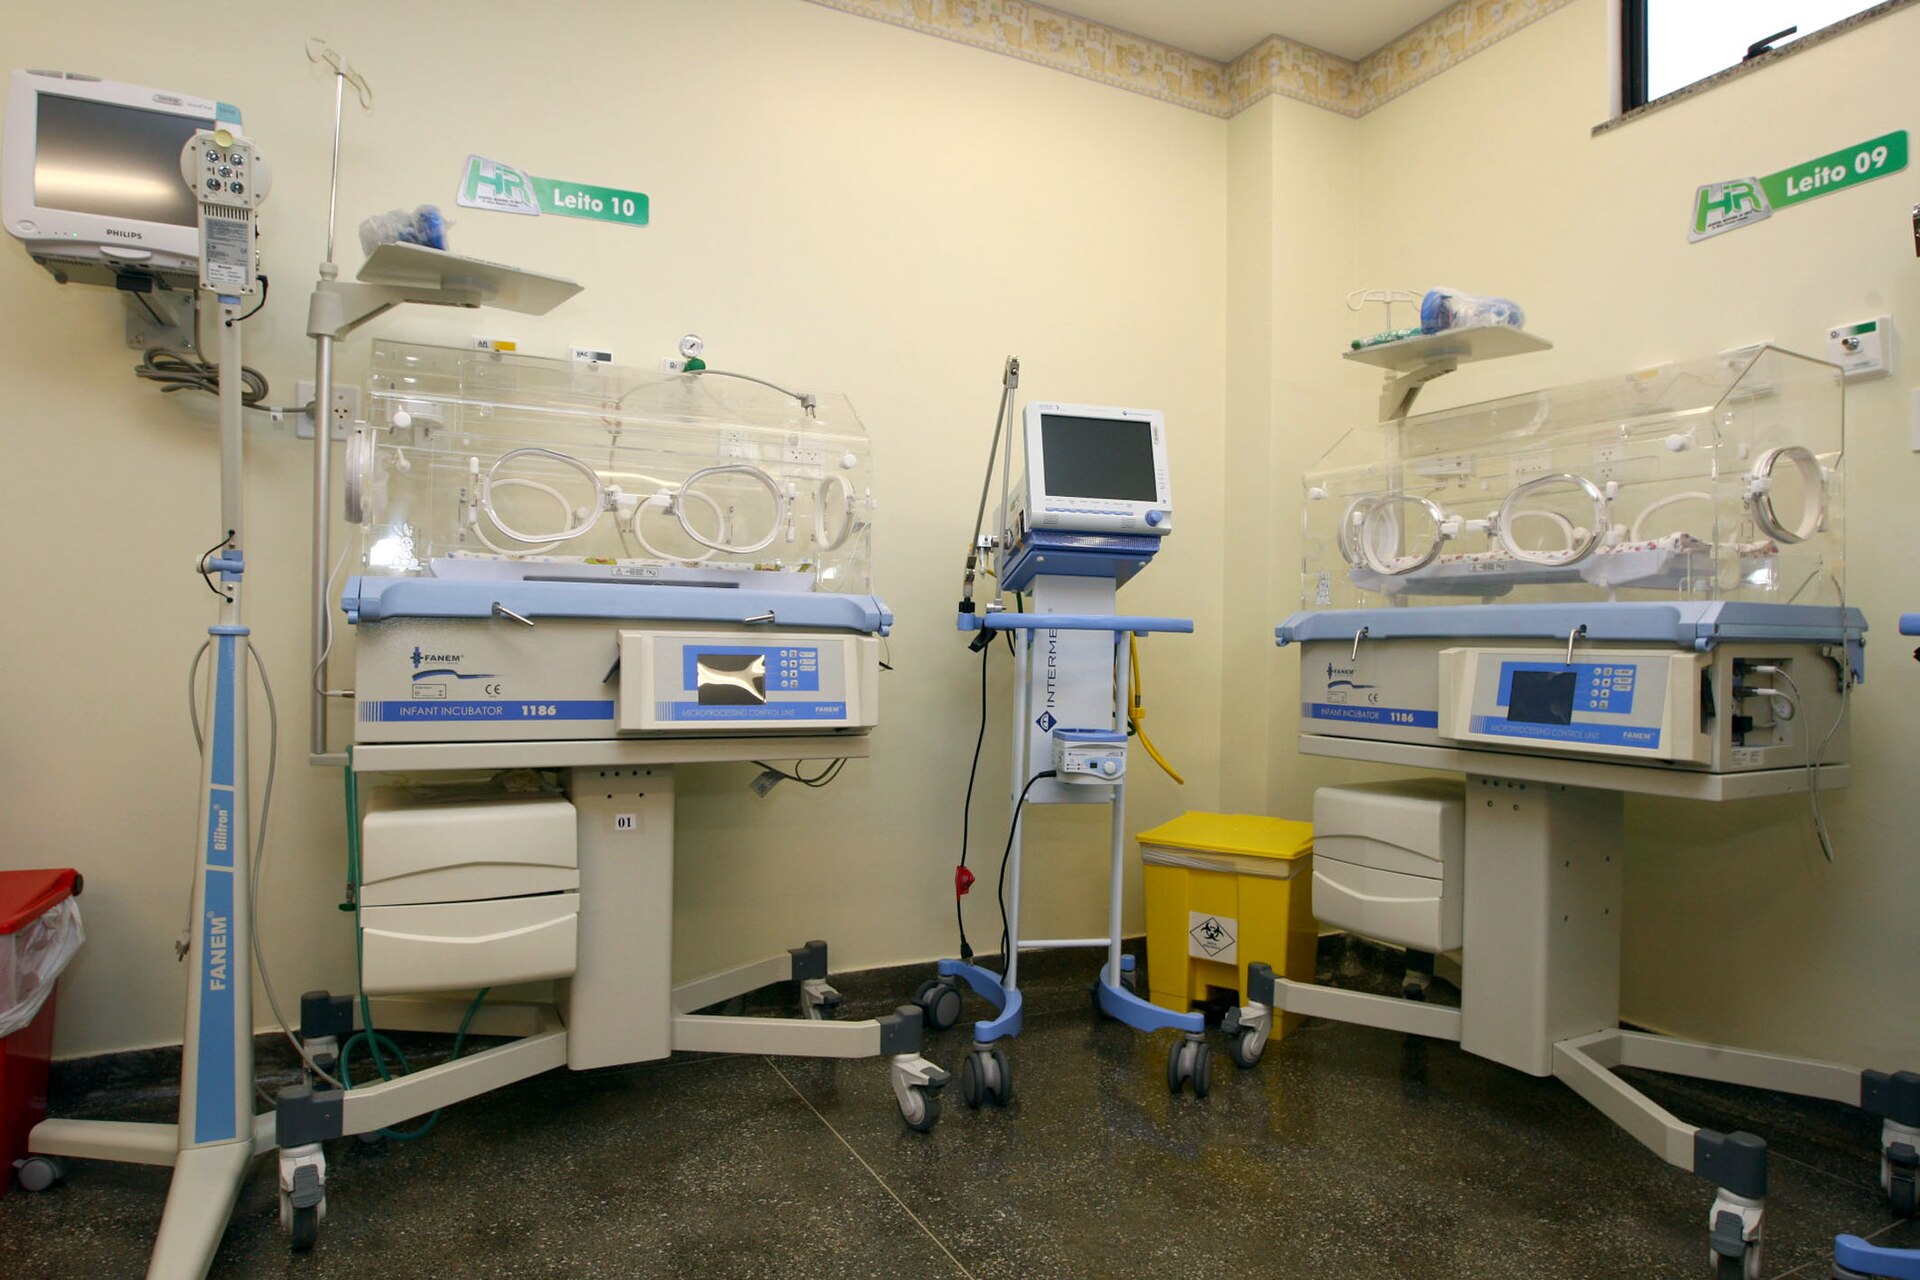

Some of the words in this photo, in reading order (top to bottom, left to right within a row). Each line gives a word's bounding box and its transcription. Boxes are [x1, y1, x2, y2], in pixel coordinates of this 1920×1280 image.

[1786, 165, 1846, 197] Leito
[1854, 145, 1888, 174] 09
[554, 188, 603, 212] Leito
[611, 197, 634, 216] 10
[106, 229, 142, 239] PHILIPS
[1047, 628, 1058, 707] INTERME
[400, 706, 438, 716] INFANT
[441, 706, 503, 716] INCUBATOR
[522, 705, 557, 716] 1186
[1321, 708, 1342, 717] INFANT
[1342, 709, 1380, 719] INCUBATOR
[1390, 712, 1415, 723] 1186
[214, 809, 228, 851] Bilitron
[618, 817, 631, 828] 01
[210, 916, 227, 991] FANEM
